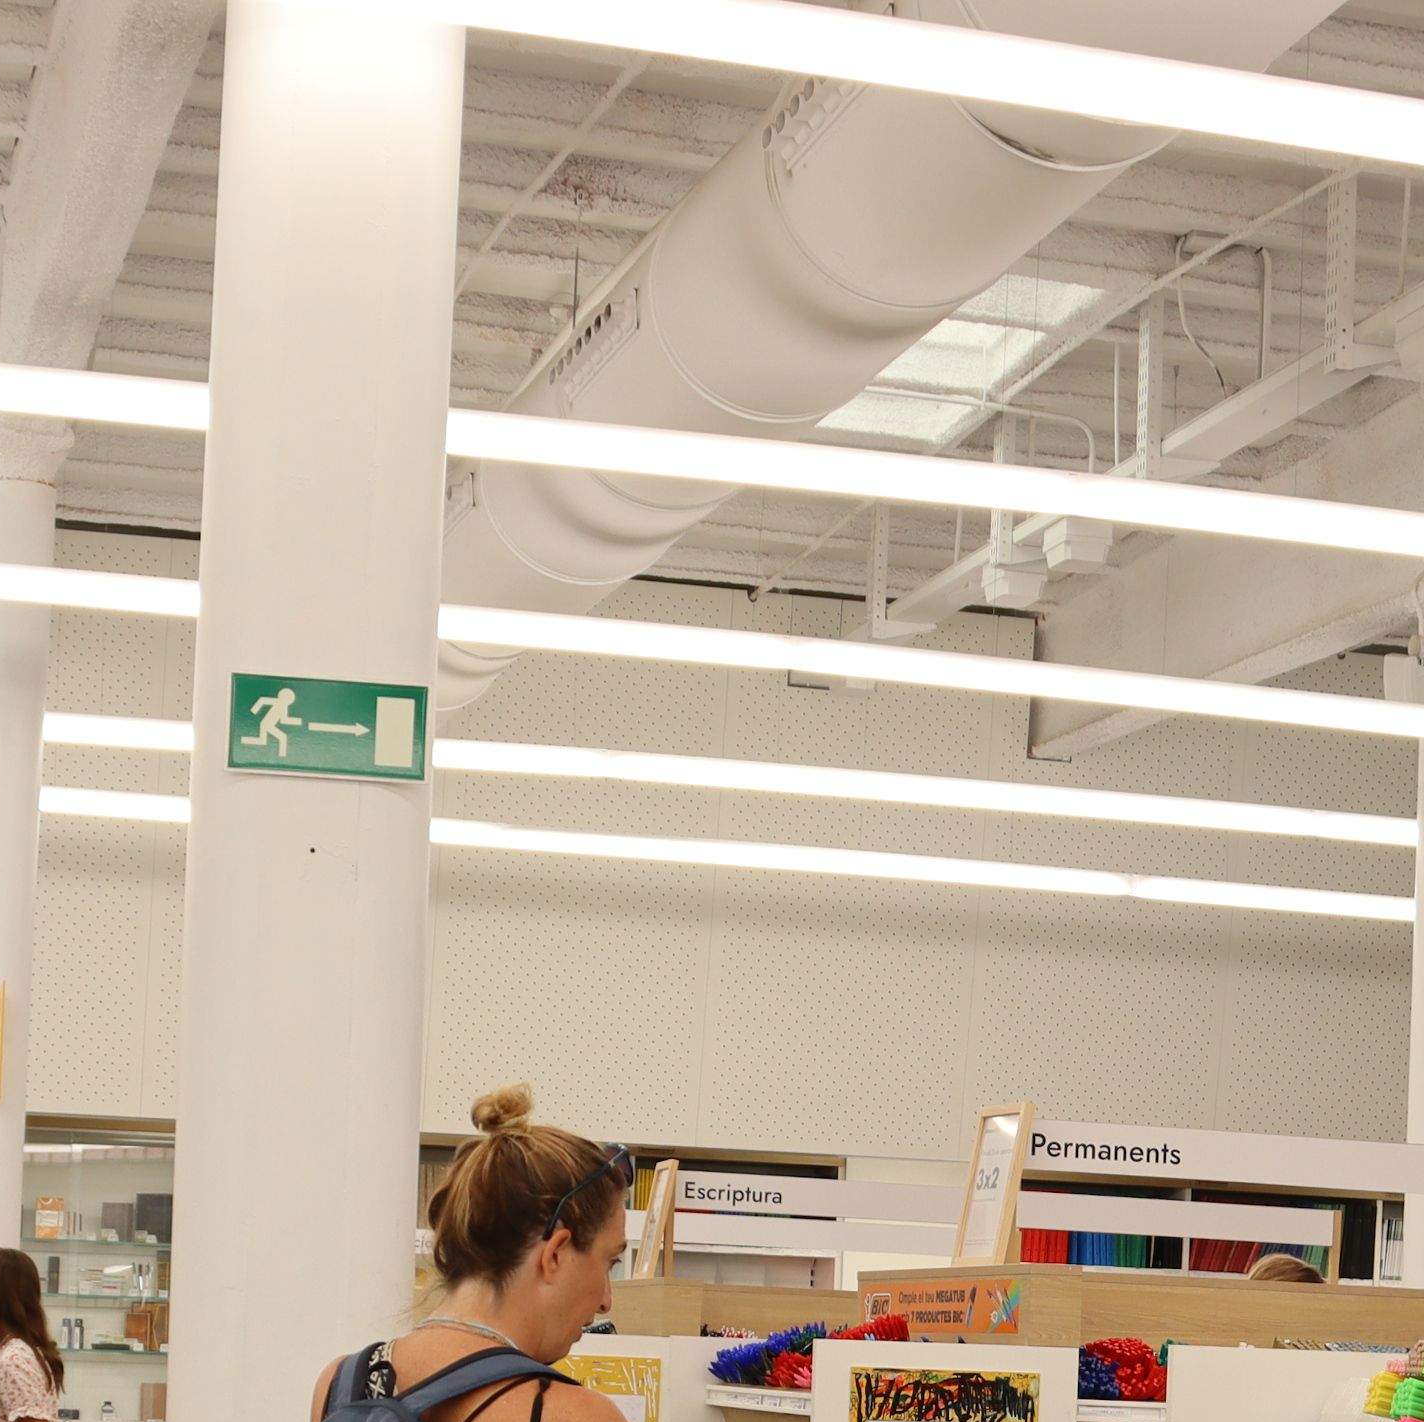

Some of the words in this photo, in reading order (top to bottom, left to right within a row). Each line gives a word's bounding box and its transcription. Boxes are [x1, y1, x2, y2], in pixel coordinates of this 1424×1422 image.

[1031, 1132, 1181, 1165] Permanents
[977, 1166, 1000, 1191] 3x2
[684, 1181, 782, 1206] Escriptura
[916, 1311, 952, 1323] PRODUCTES
